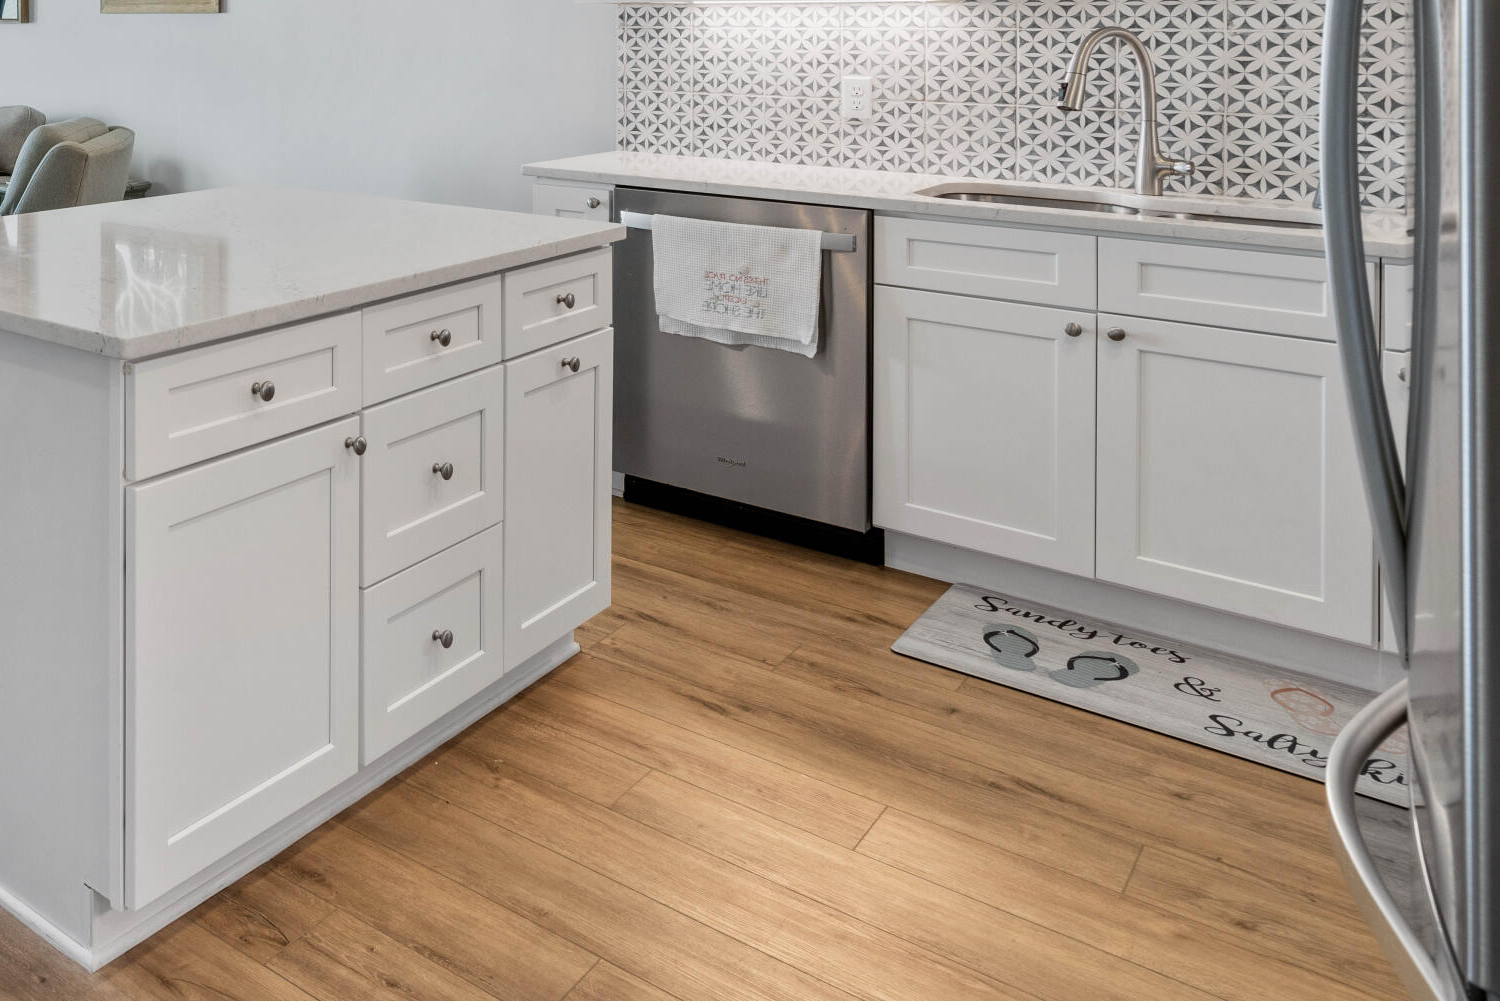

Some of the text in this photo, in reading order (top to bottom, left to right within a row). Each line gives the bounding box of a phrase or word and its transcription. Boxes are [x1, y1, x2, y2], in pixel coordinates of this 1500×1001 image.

[974, 595, 1192, 664] Sandy toes
[1173, 676, 1221, 702] &
[1203, 714, 1328, 769] Salty
